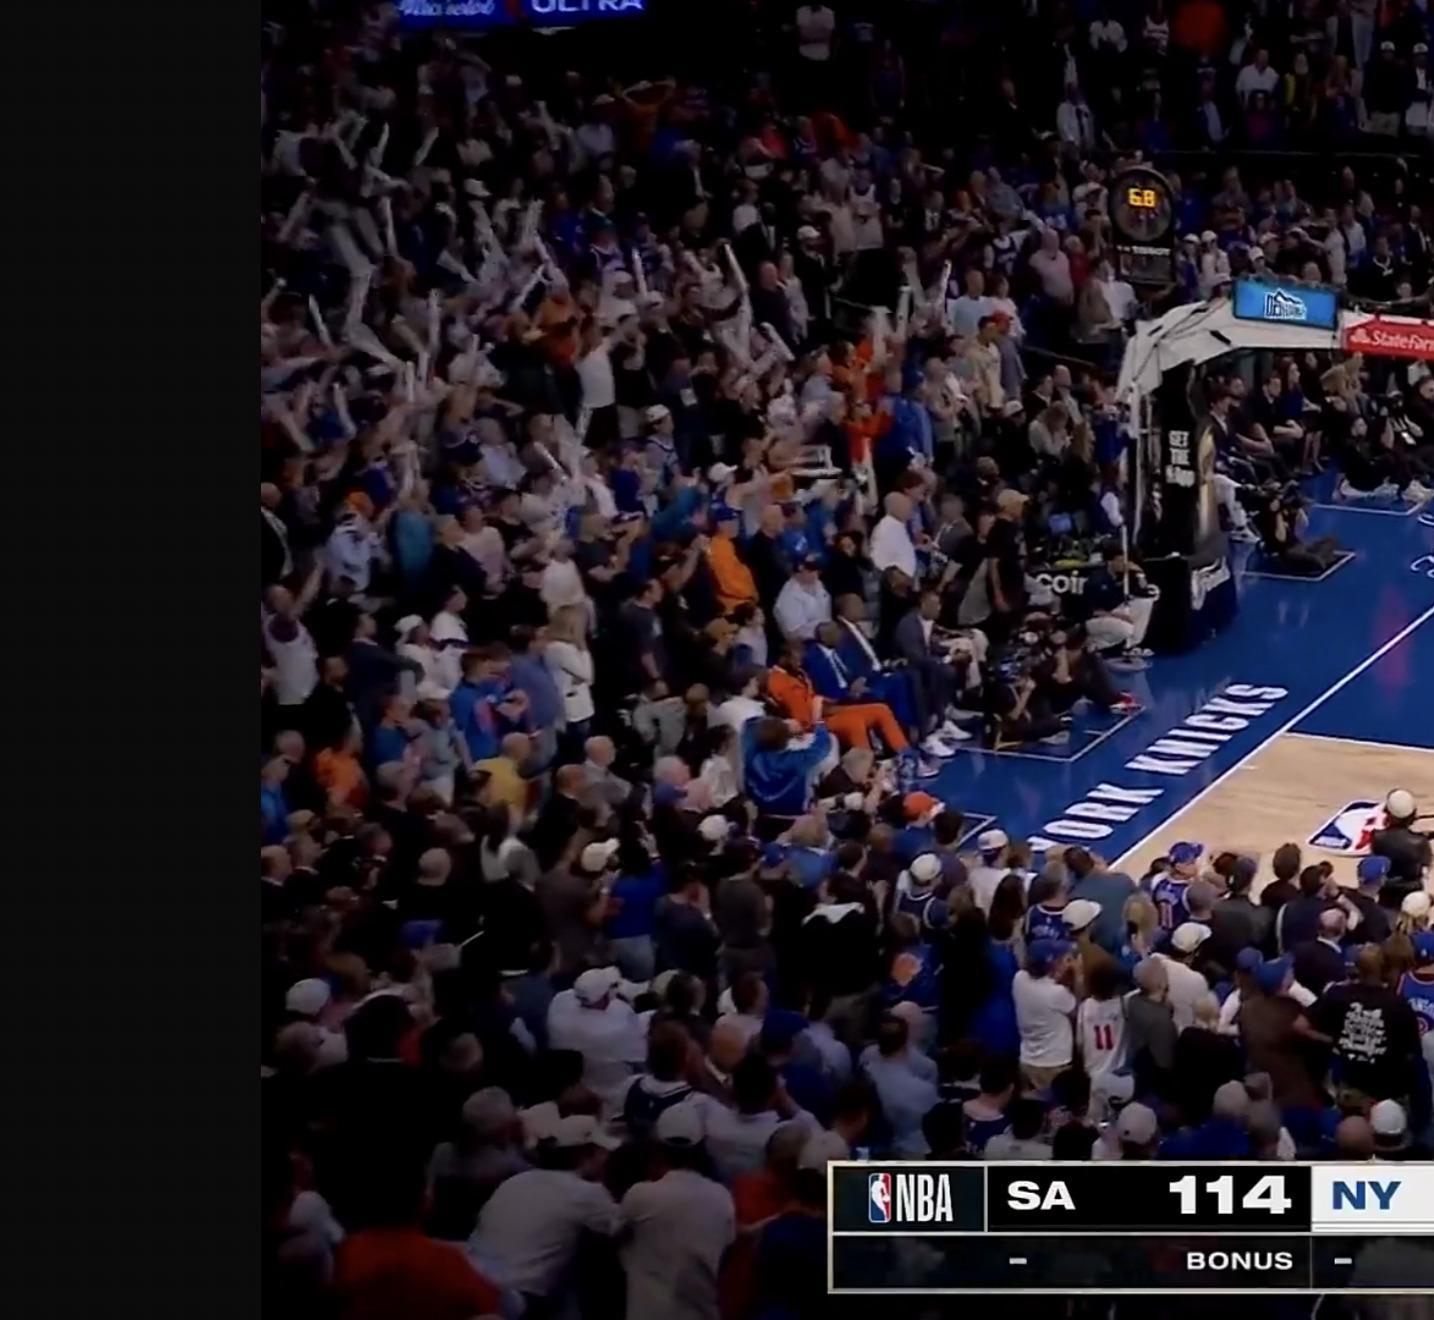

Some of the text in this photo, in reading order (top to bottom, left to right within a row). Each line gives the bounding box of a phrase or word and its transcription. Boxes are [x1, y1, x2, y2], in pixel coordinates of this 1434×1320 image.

[1026, 684, 1289, 852] YORK KNICKS
[1093, 1024, 1114, 1050] 11
